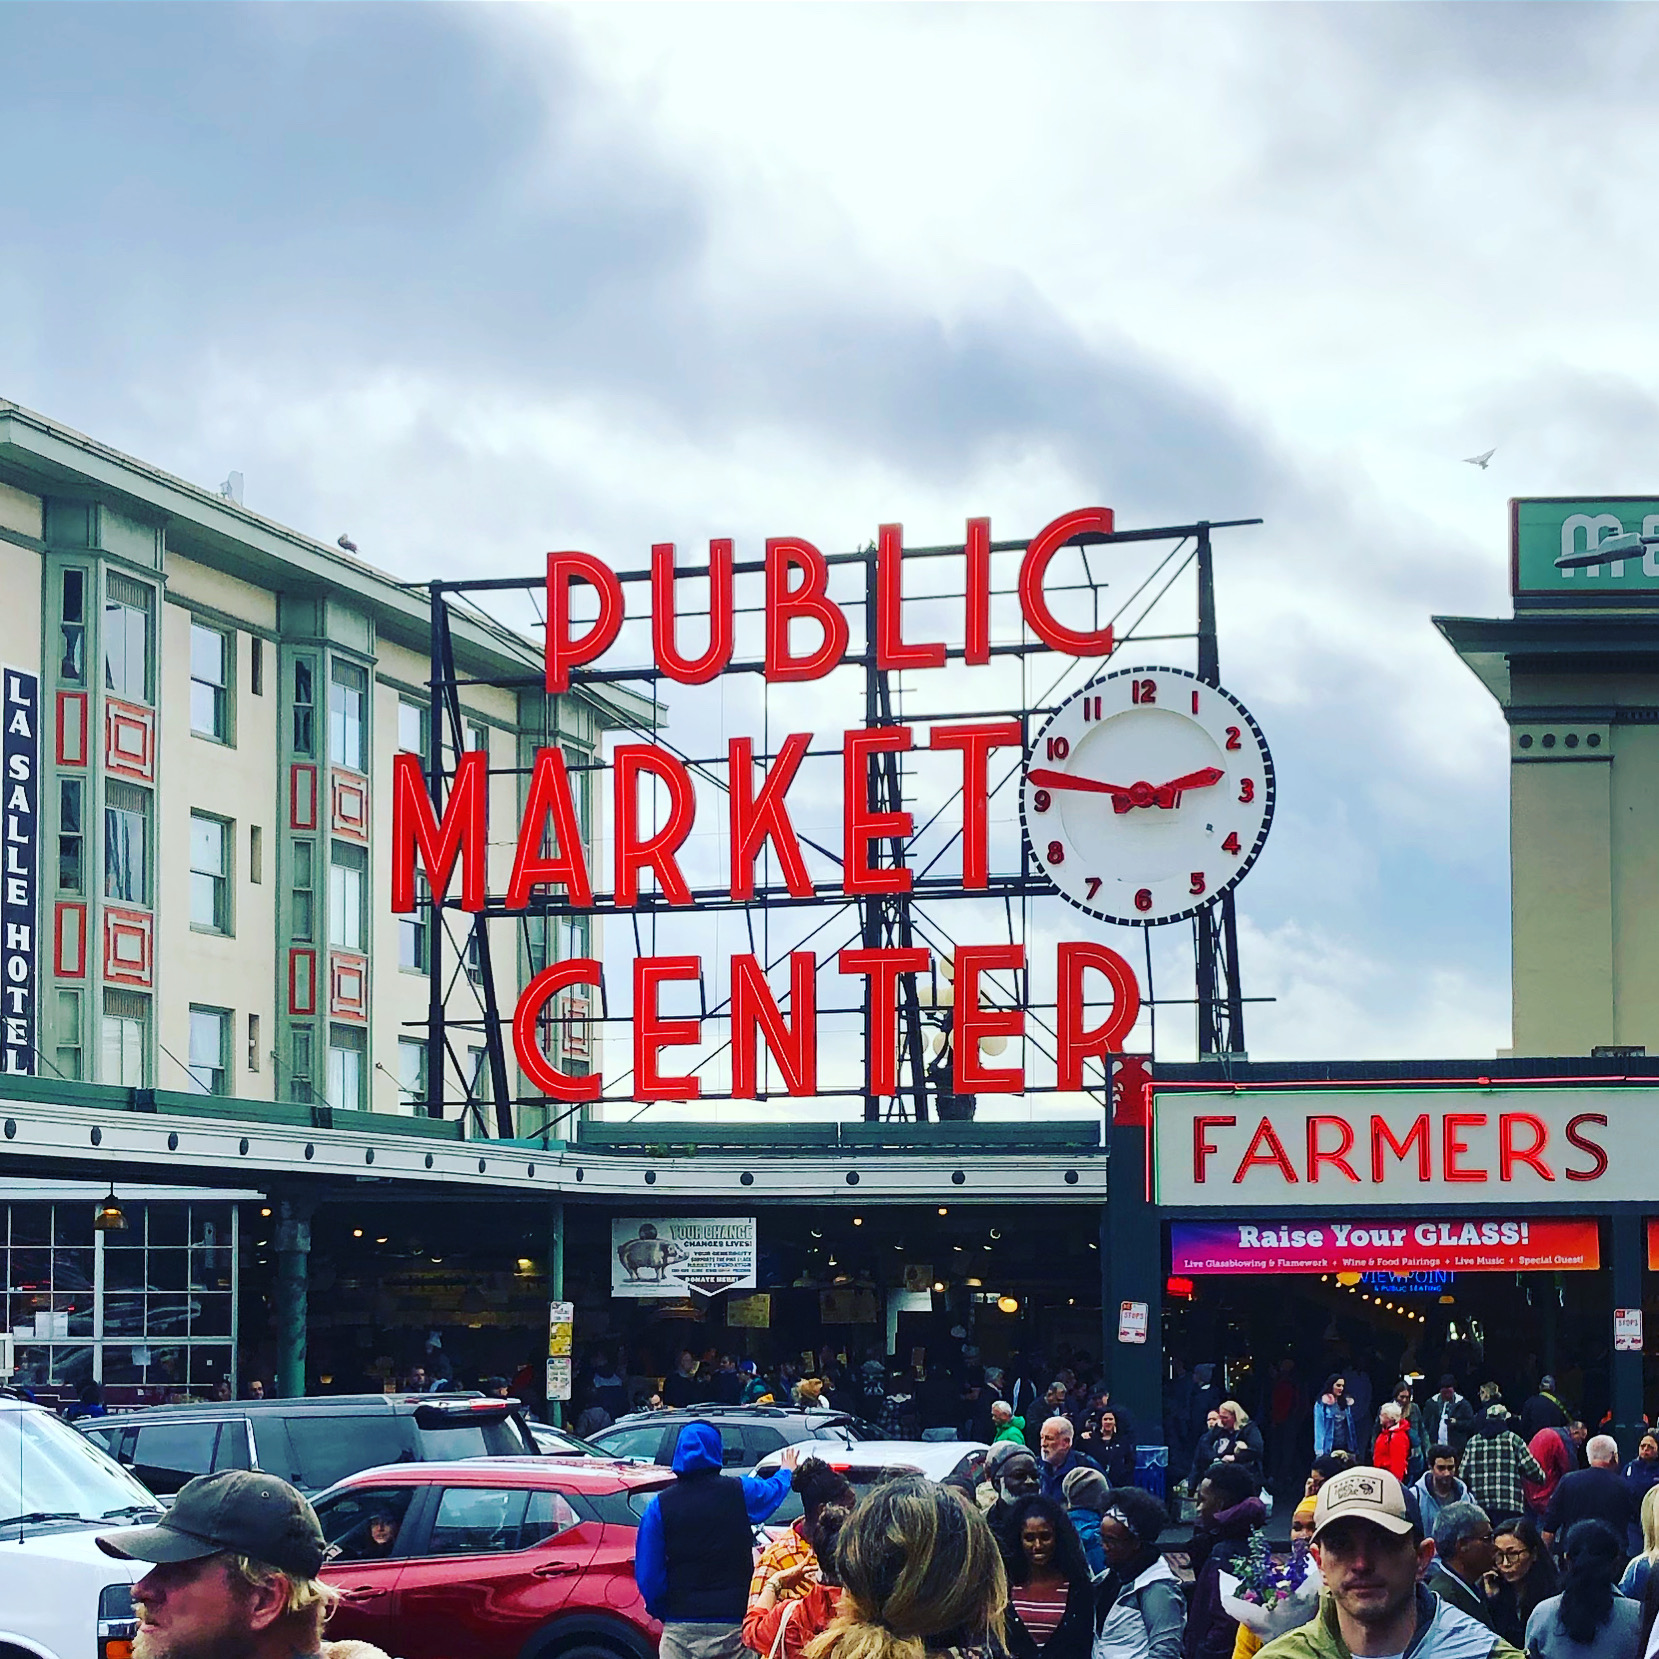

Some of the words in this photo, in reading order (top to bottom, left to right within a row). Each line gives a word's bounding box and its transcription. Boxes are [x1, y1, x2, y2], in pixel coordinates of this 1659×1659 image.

[545, 507, 1114, 694] PUBLIC
[1132, 679, 1157, 704] 12
[1192, 690, 1199, 715] 1
[8, 675, 32, 738] LA
[1083, 696, 1102, 721] 11
[1046, 736, 1070, 761] 10
[1225, 726, 1242, 751] 2
[1034, 789, 1051, 812] 9
[1238, 778, 1254, 803] 3
[391, 721, 1022, 913] MARKET
[6, 754, 31, 906] SALLE
[1047, 840, 1065, 865] 8
[1221, 831, 1242, 855] 4
[1085, 877, 1103, 901] 7
[1189, 871, 1206, 895] 5
[1135, 888, 1152, 912] 6
[6, 922, 30, 1076] HOTEL
[512, 942, 1141, 1103] CENTER
[1192, 1112, 1609, 1185] FARMERS
[670, 1225, 703, 1240] YOUR
[704, 1224, 753, 1240] CHANGE
[1238, 1225, 1324, 1248] Raise
[1331, 1224, 1407, 1247] Your
[1414, 1222, 1529, 1246] GLASS!
[1184, 1259, 1204, 1268] Live
[1206, 1258, 1267, 1269] Glassblowing
[1269, 1258, 1275, 1267] &
[1277, 1258, 1328, 1267] Flamework
[1342, 1258, 1366, 1266] Wine
[1368, 1258, 1375, 1266] &
[1377, 1257, 1399, 1266] Food
[1402, 1256, 1441, 1268] Pairings
[1454, 1256, 1475, 1265] Live
[1476, 1256, 1505, 1265] Music
[1518, 1254, 1552, 1266] Special
[1553, 1254, 1584, 1264] Guest!
